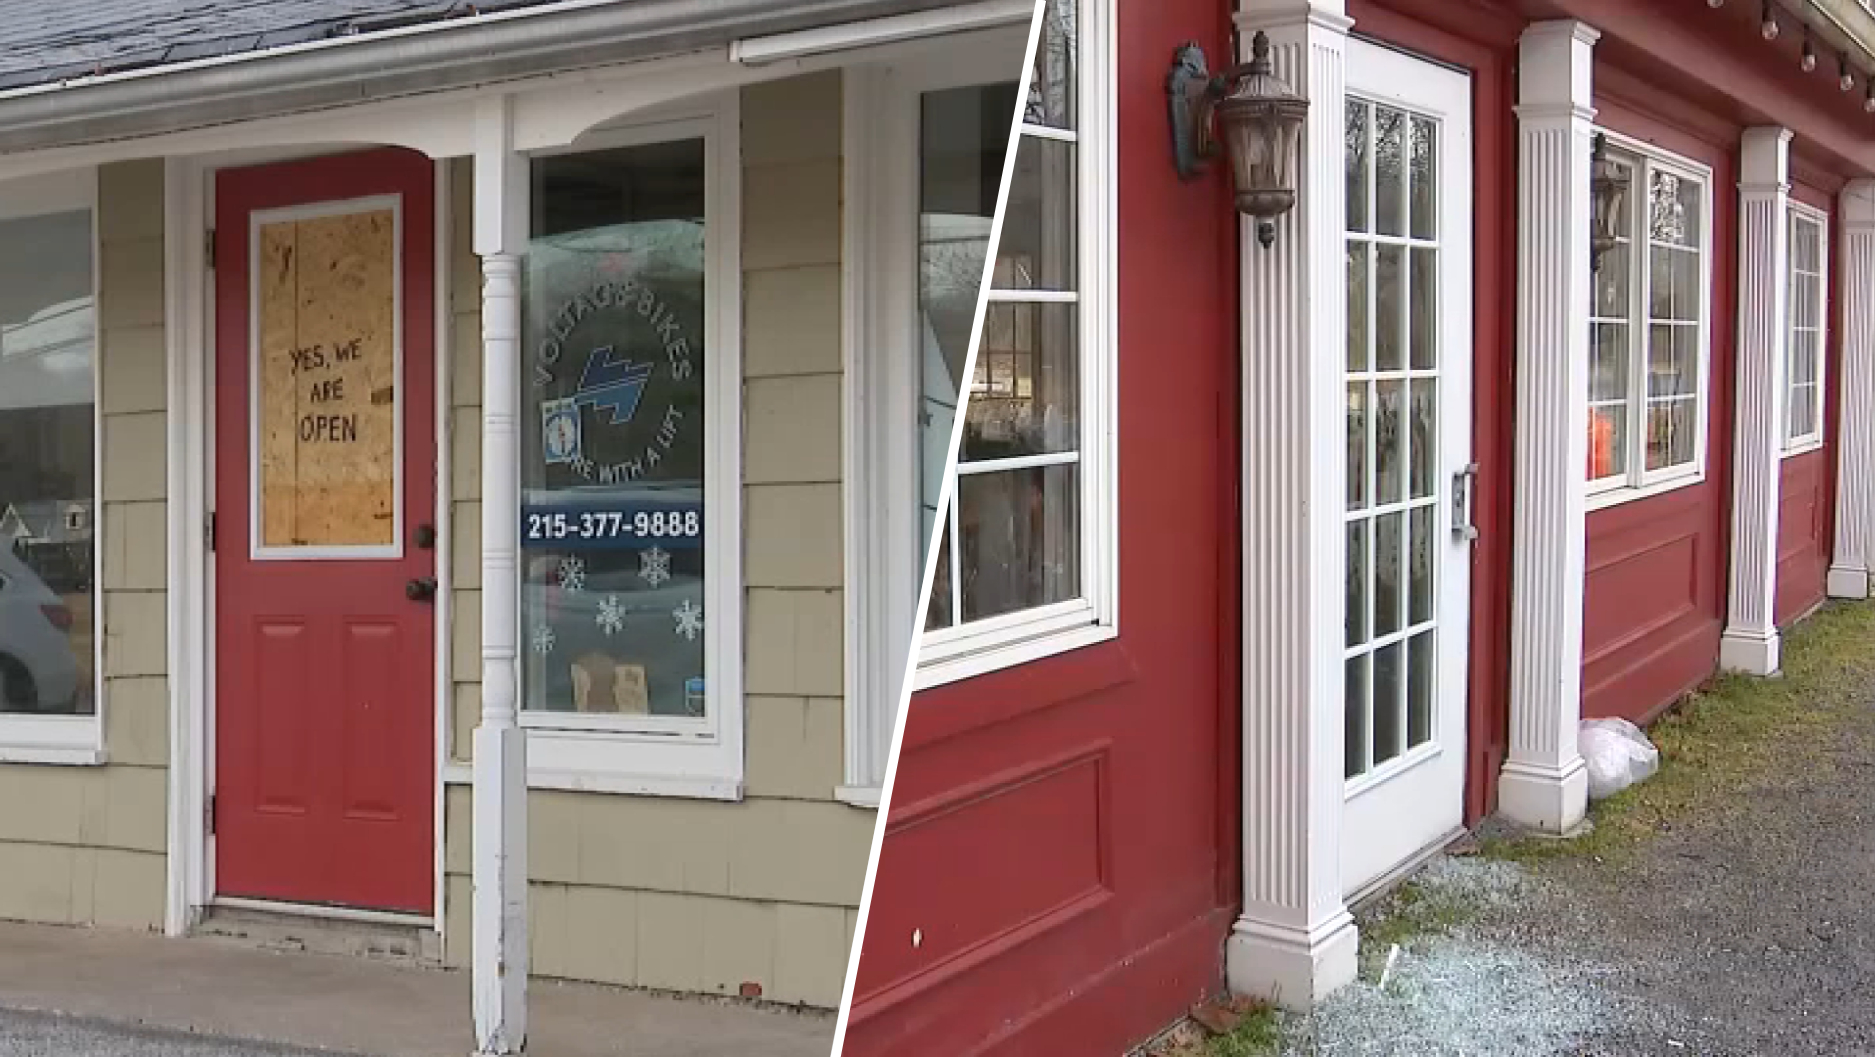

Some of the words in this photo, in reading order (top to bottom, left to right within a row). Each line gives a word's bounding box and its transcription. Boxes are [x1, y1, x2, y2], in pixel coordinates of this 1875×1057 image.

[533, 277, 638, 387] VOLTAGE
[638, 288, 692, 381] BIKES
[289, 344, 330, 376] YES,
[333, 338, 362, 362] WE
[310, 377, 343, 403] ARE
[301, 413, 357, 442] OPEN
[599, 458, 643, 482] WITH
[646, 447, 661, 468] A
[656, 404, 683, 448] LIFT
[528, 512, 699, 538] 215-377-9888
